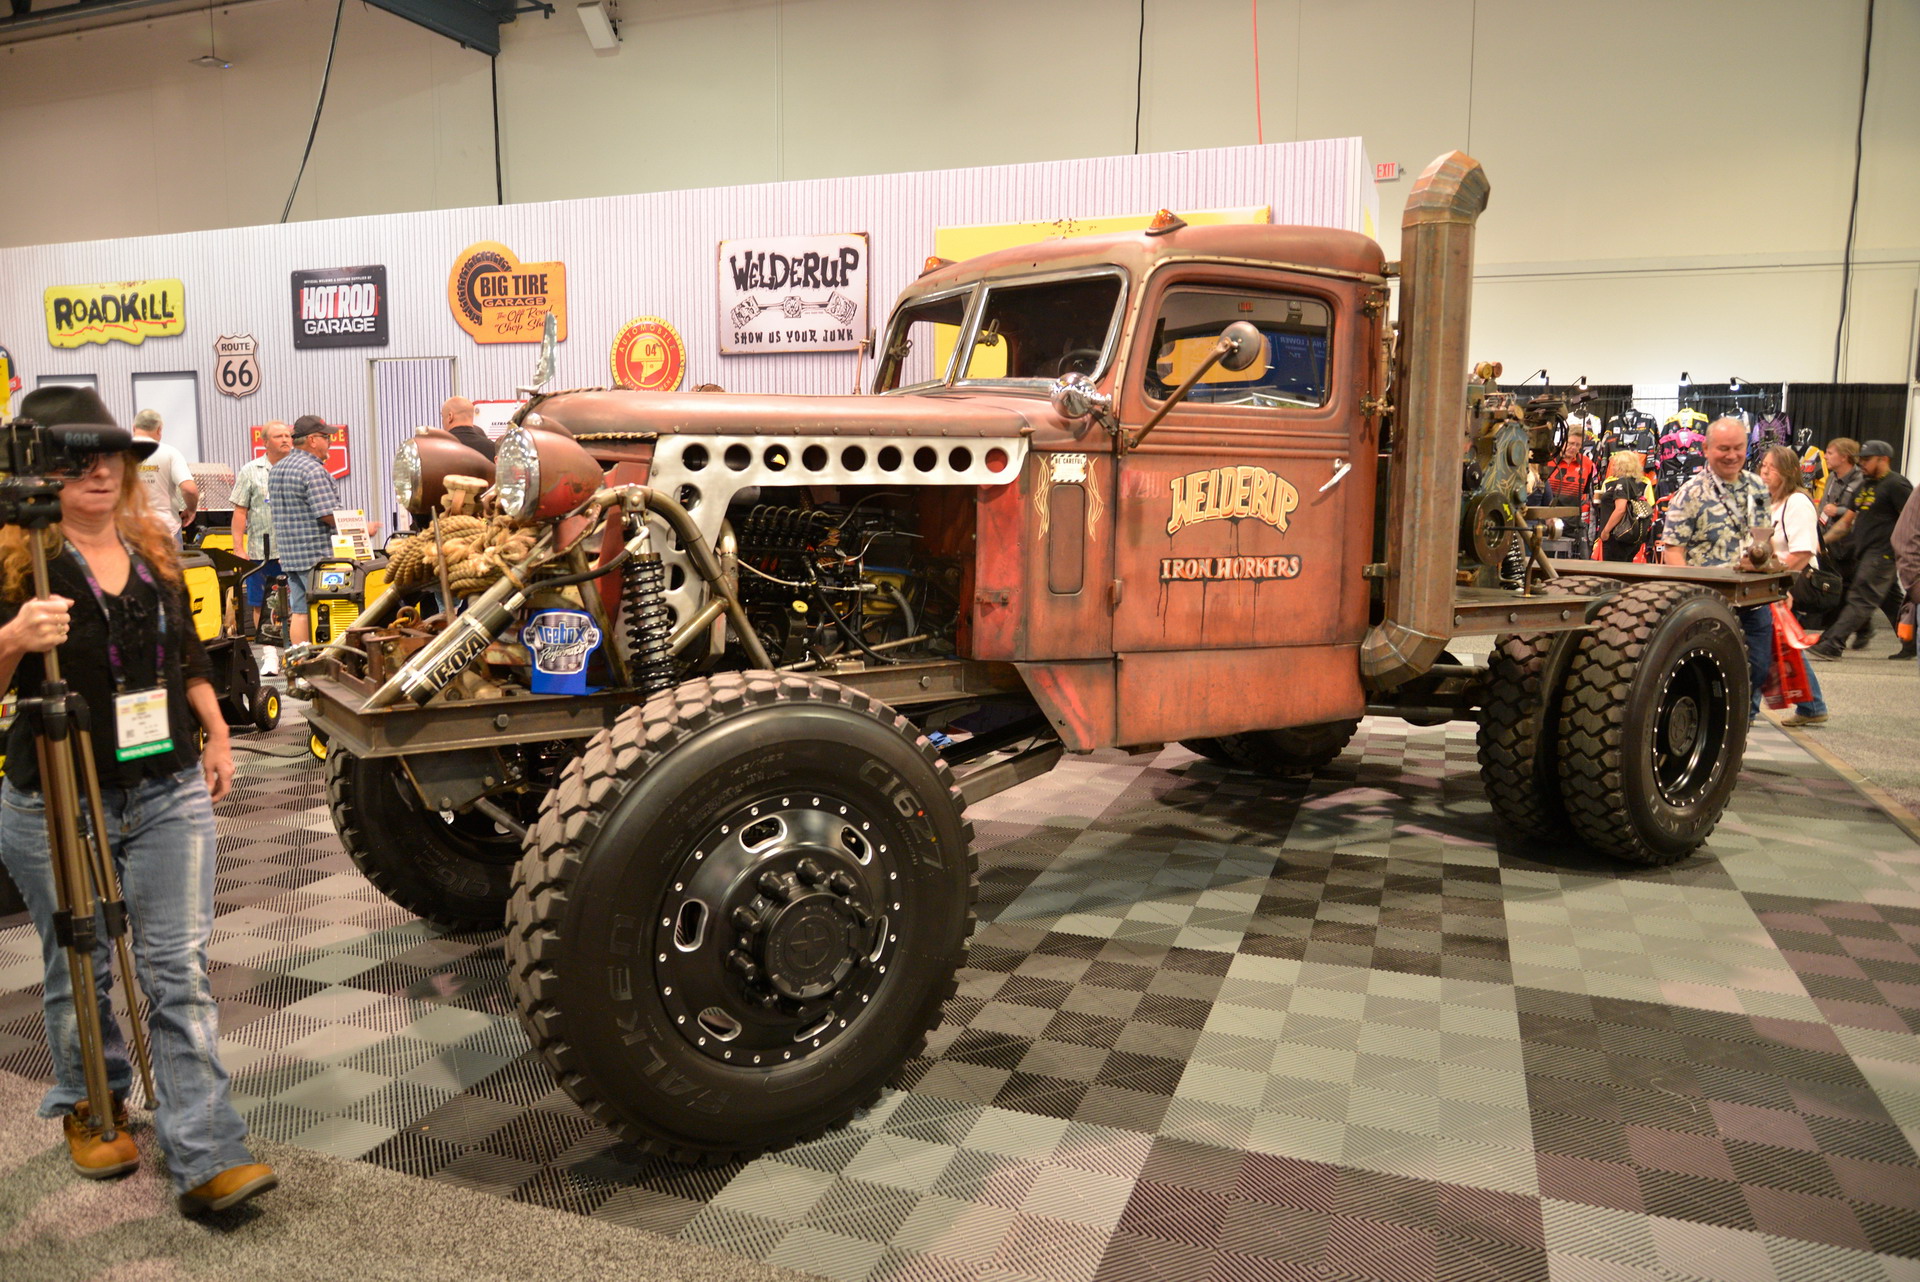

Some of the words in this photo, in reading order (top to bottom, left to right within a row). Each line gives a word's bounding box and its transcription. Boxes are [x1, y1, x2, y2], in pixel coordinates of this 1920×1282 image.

[1376, 162, 1396, 178] EXIT
[730, 247, 859, 291] WELDERUP
[480, 275, 508, 297] BIG
[512, 273, 549, 296] TIRE
[54, 291, 174, 330] ROADKILL
[302, 285, 337, 319] HOT
[338, 283, 376, 318] ROD
[484, 296, 544, 307] GARAGE
[304, 317, 376, 335] GARAGE
[507, 308, 526, 324] Off
[221, 342, 251, 352] ROUTE
[618, 324, 677, 353] AUTOMOBILE
[735, 331, 763, 345] SHOW
[769, 330, 781, 344] US
[786, 328, 818, 344] YOUR
[823, 328, 854, 342] JUNK
[645, 343, 657, 357] 04
[222, 359, 253, 388] 66
[1055, 457, 1061, 465] BE
[1063, 457, 1083, 465] CAREFUL
[1166, 465, 1299, 535] WELDERUP
[1160, 556, 1213, 580] IRON
[1216, 555, 1300, 579] WORKERS
[538, 642, 589, 665] Performance
